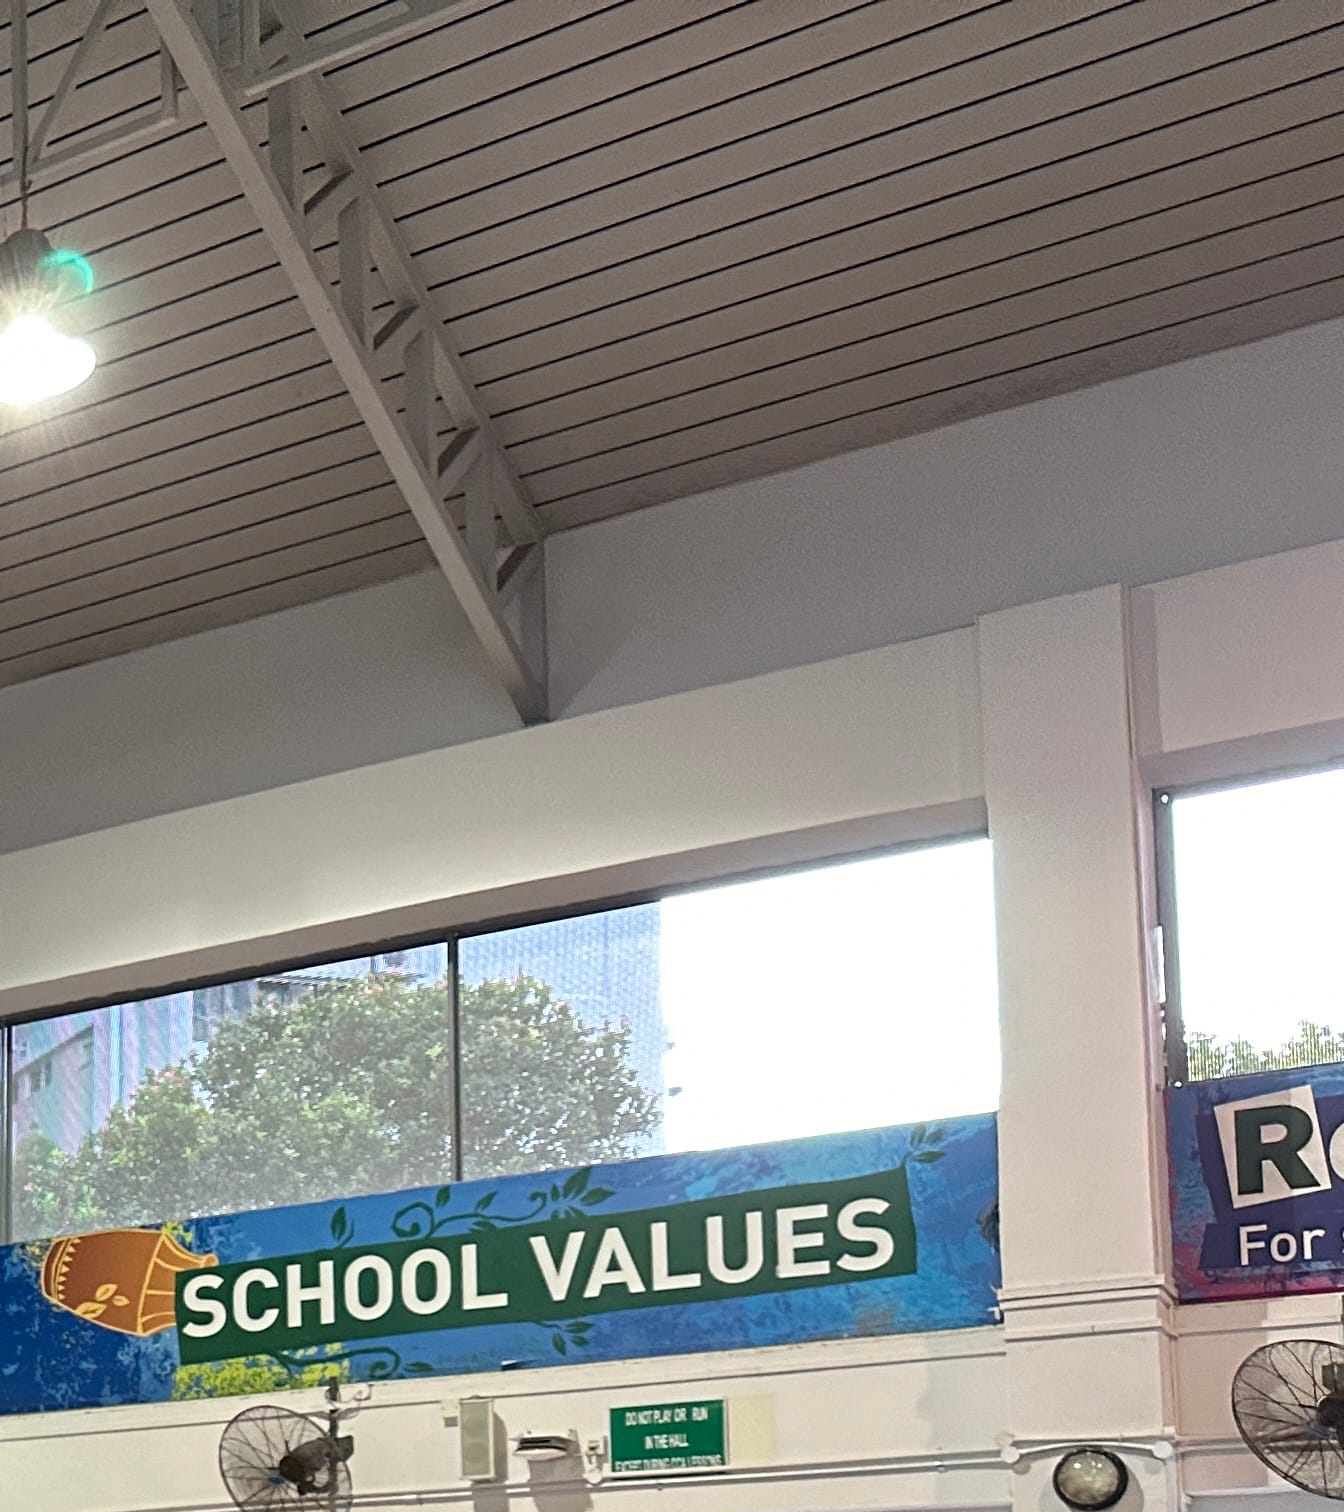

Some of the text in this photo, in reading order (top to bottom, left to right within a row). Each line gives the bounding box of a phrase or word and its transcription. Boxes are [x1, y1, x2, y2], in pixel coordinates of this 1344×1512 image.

[1233, 1104, 1344, 1196] R
[181, 1197, 895, 1338] SCHOOL VALUES
[1238, 1223, 1326, 1266] For
[674, 1407, 687, 1422] OR
